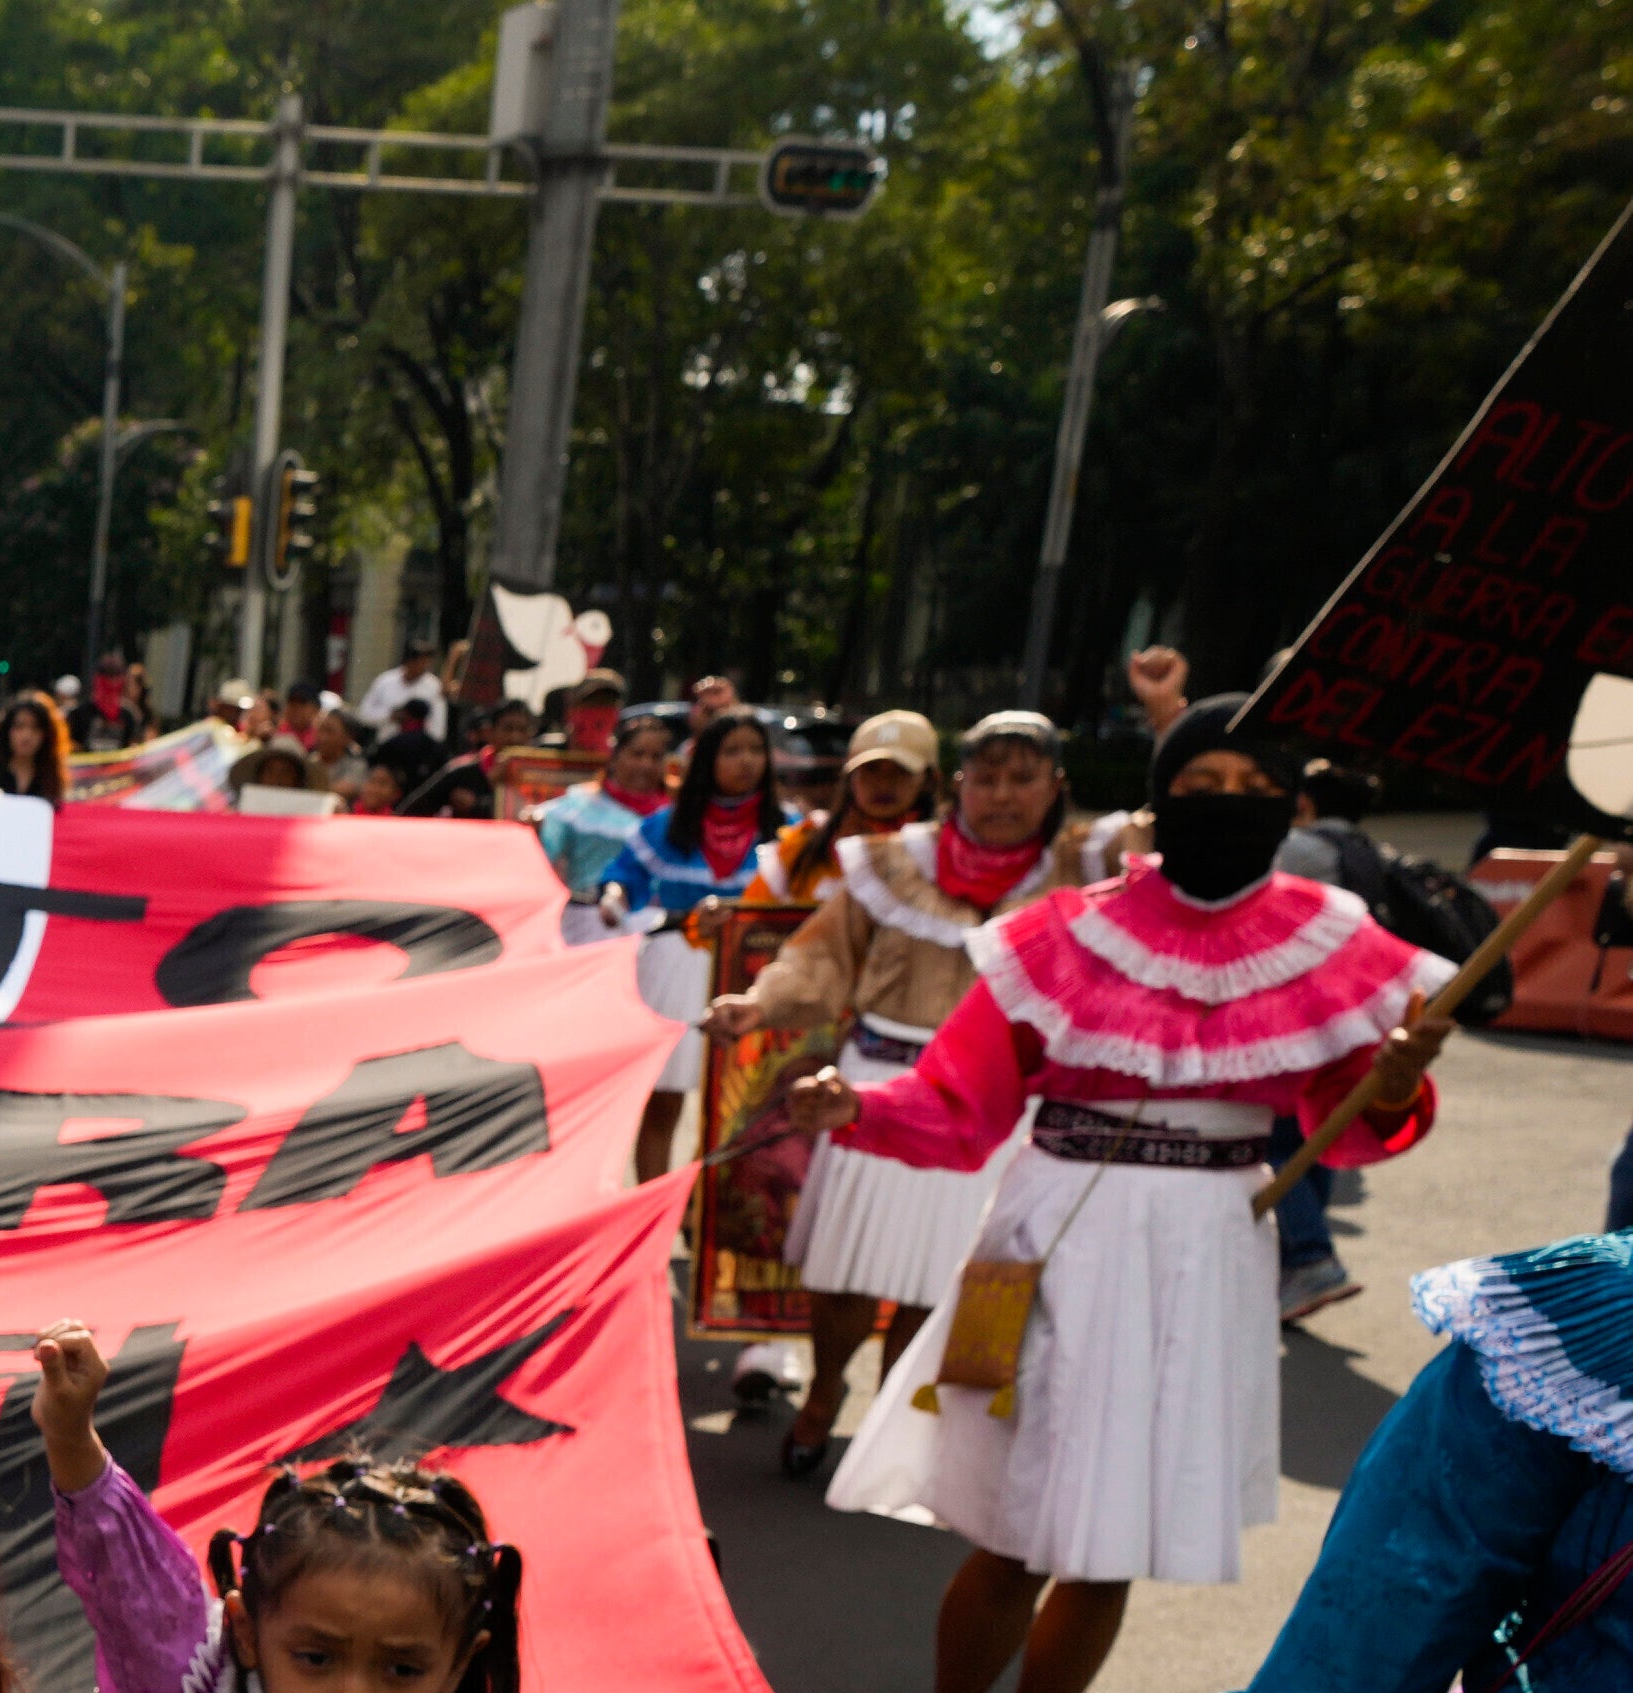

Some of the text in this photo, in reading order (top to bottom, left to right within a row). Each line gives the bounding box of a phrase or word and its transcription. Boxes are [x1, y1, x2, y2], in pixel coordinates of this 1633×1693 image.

[1456, 400, 1633, 512] ALTO
[1409, 487, 1590, 578] A LA
[1309, 602, 1545, 714] CONTRA
[1363, 547, 1633, 665] GUERRA E
[1268, 670, 1569, 791] DEL EZLN
